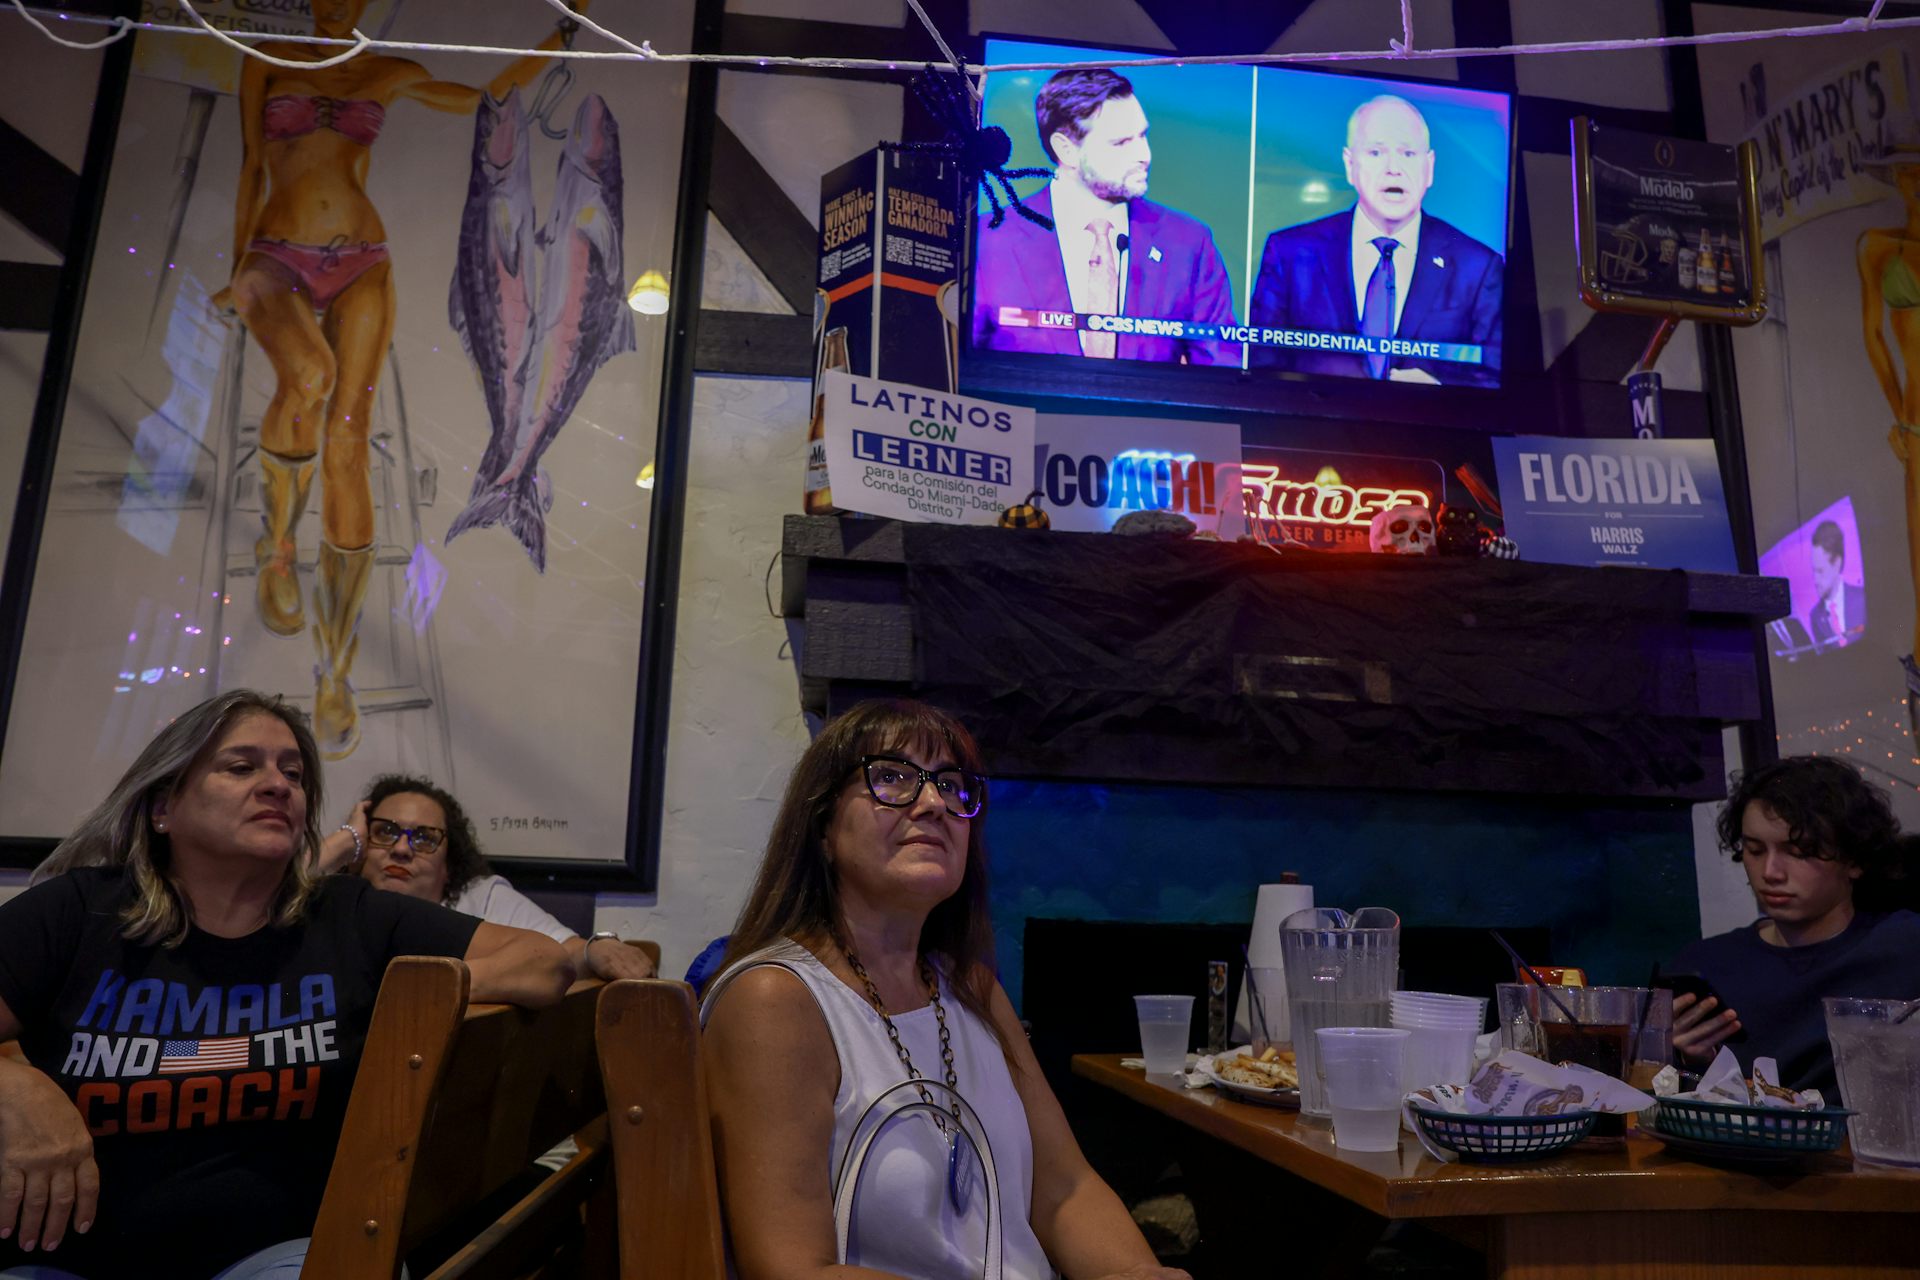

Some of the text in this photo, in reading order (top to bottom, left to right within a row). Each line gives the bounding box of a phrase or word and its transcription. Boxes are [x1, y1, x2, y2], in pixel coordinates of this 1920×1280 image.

[1639, 176, 1694, 201] Modelo
[825, 191, 875, 230] WINNING
[887, 211, 948, 239] GANADORA
[888, 195, 955, 226] TEMPORADA
[823, 214, 868, 252] SEASON
[1040, 312, 1440, 358] LIVE CBS NEWS VICE PRESIDENTIAL DEBATE
[851, 383, 1012, 433] LATINOS
[909, 419, 957, 443] CON
[856, 432, 1010, 484] LERNER
[862, 475, 1006, 513] Condado Miami-Dade
[865, 465, 998, 498] para la Comisión del
[1046, 453, 1217, 515] COACH!
[1518, 453, 1702, 505] FLORIDA
[908, 498, 964, 519] Distrito 7
[1604, 511, 1623, 520] FOR
[1323, 527, 1365, 545] BEER
[1590, 526, 1644, 545] HARRIS
[1602, 544, 1639, 555] WALZ
[76, 968, 337, 1036] KAMALA
[60, 1020, 340, 1078] AND THE
[76, 1066, 321, 1137] COACH
